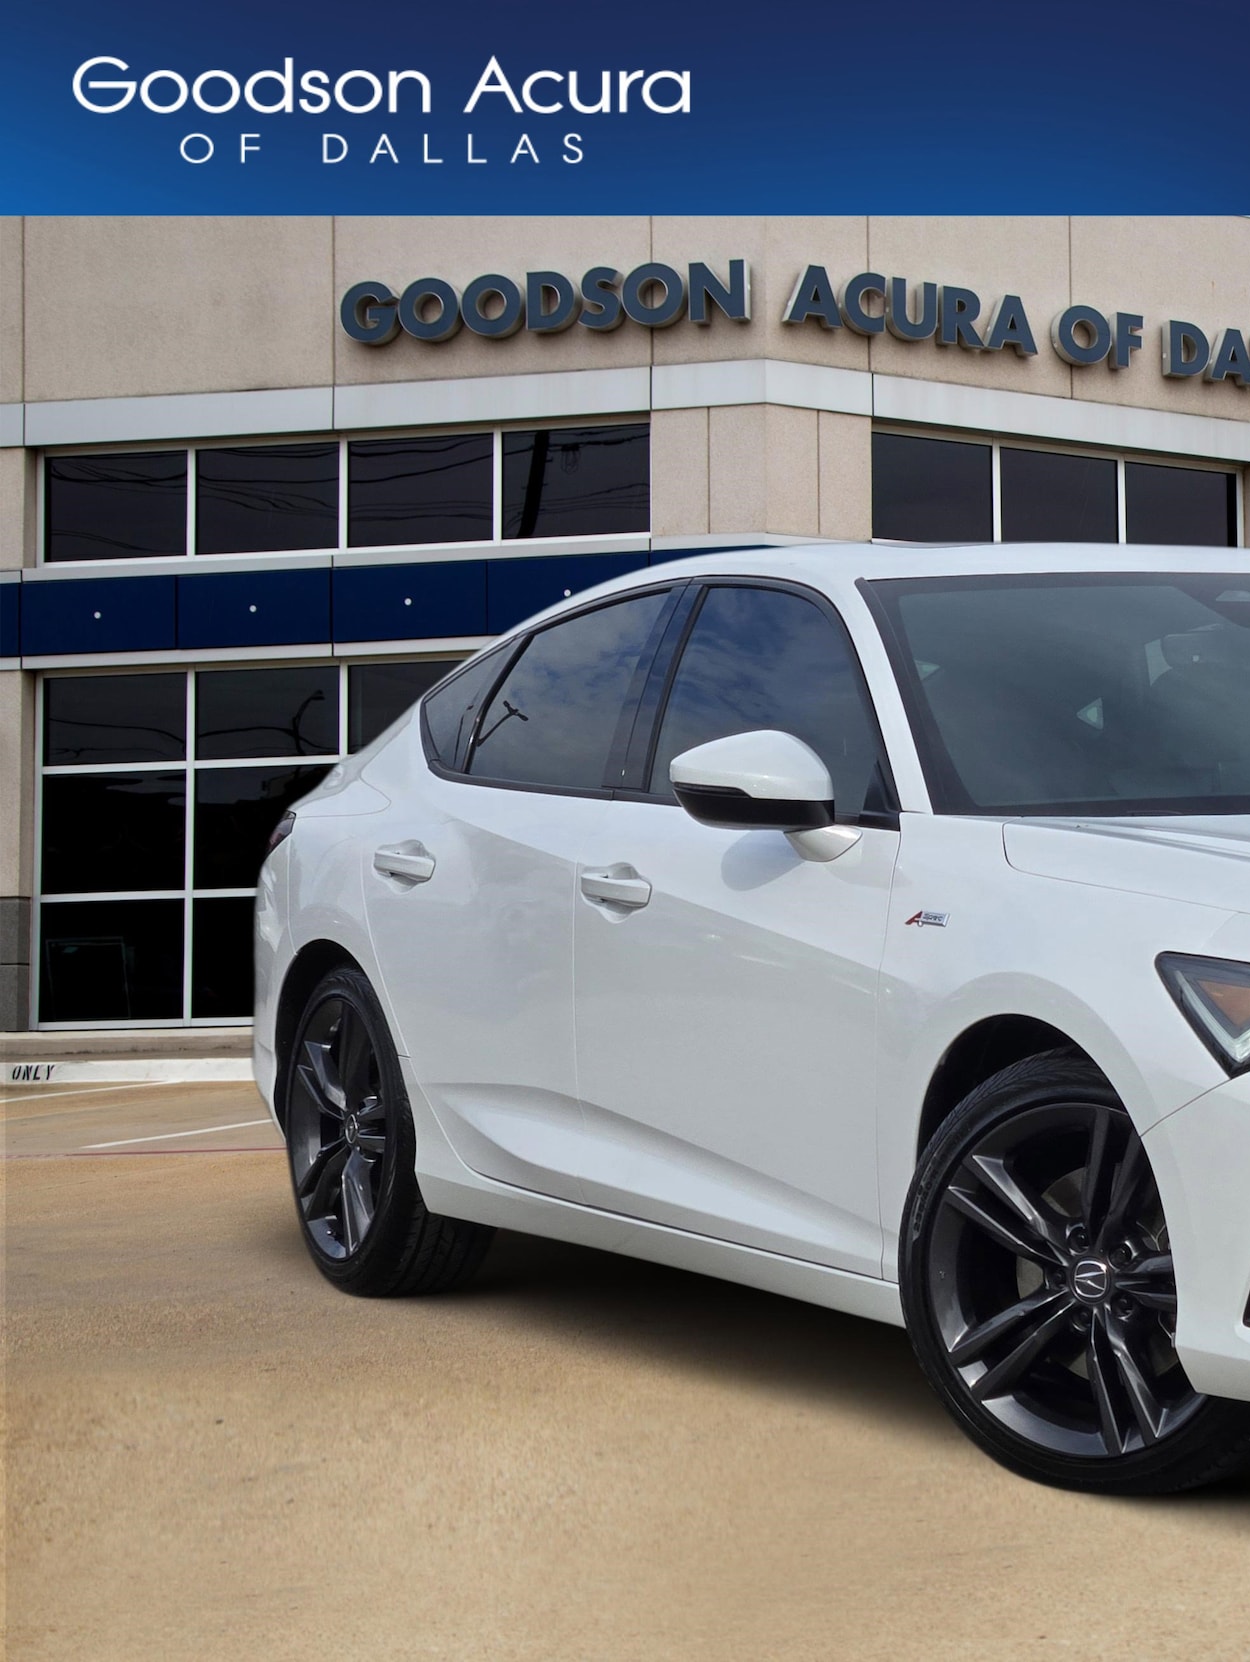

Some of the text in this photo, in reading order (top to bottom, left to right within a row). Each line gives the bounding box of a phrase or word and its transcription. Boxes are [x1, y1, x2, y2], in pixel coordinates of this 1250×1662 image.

[341, 258, 751, 346] GOODSON
[782, 264, 1038, 358] ACURA
[1051, 304, 1143, 369] OF
[12, 1064, 55, 1081] ONLY
